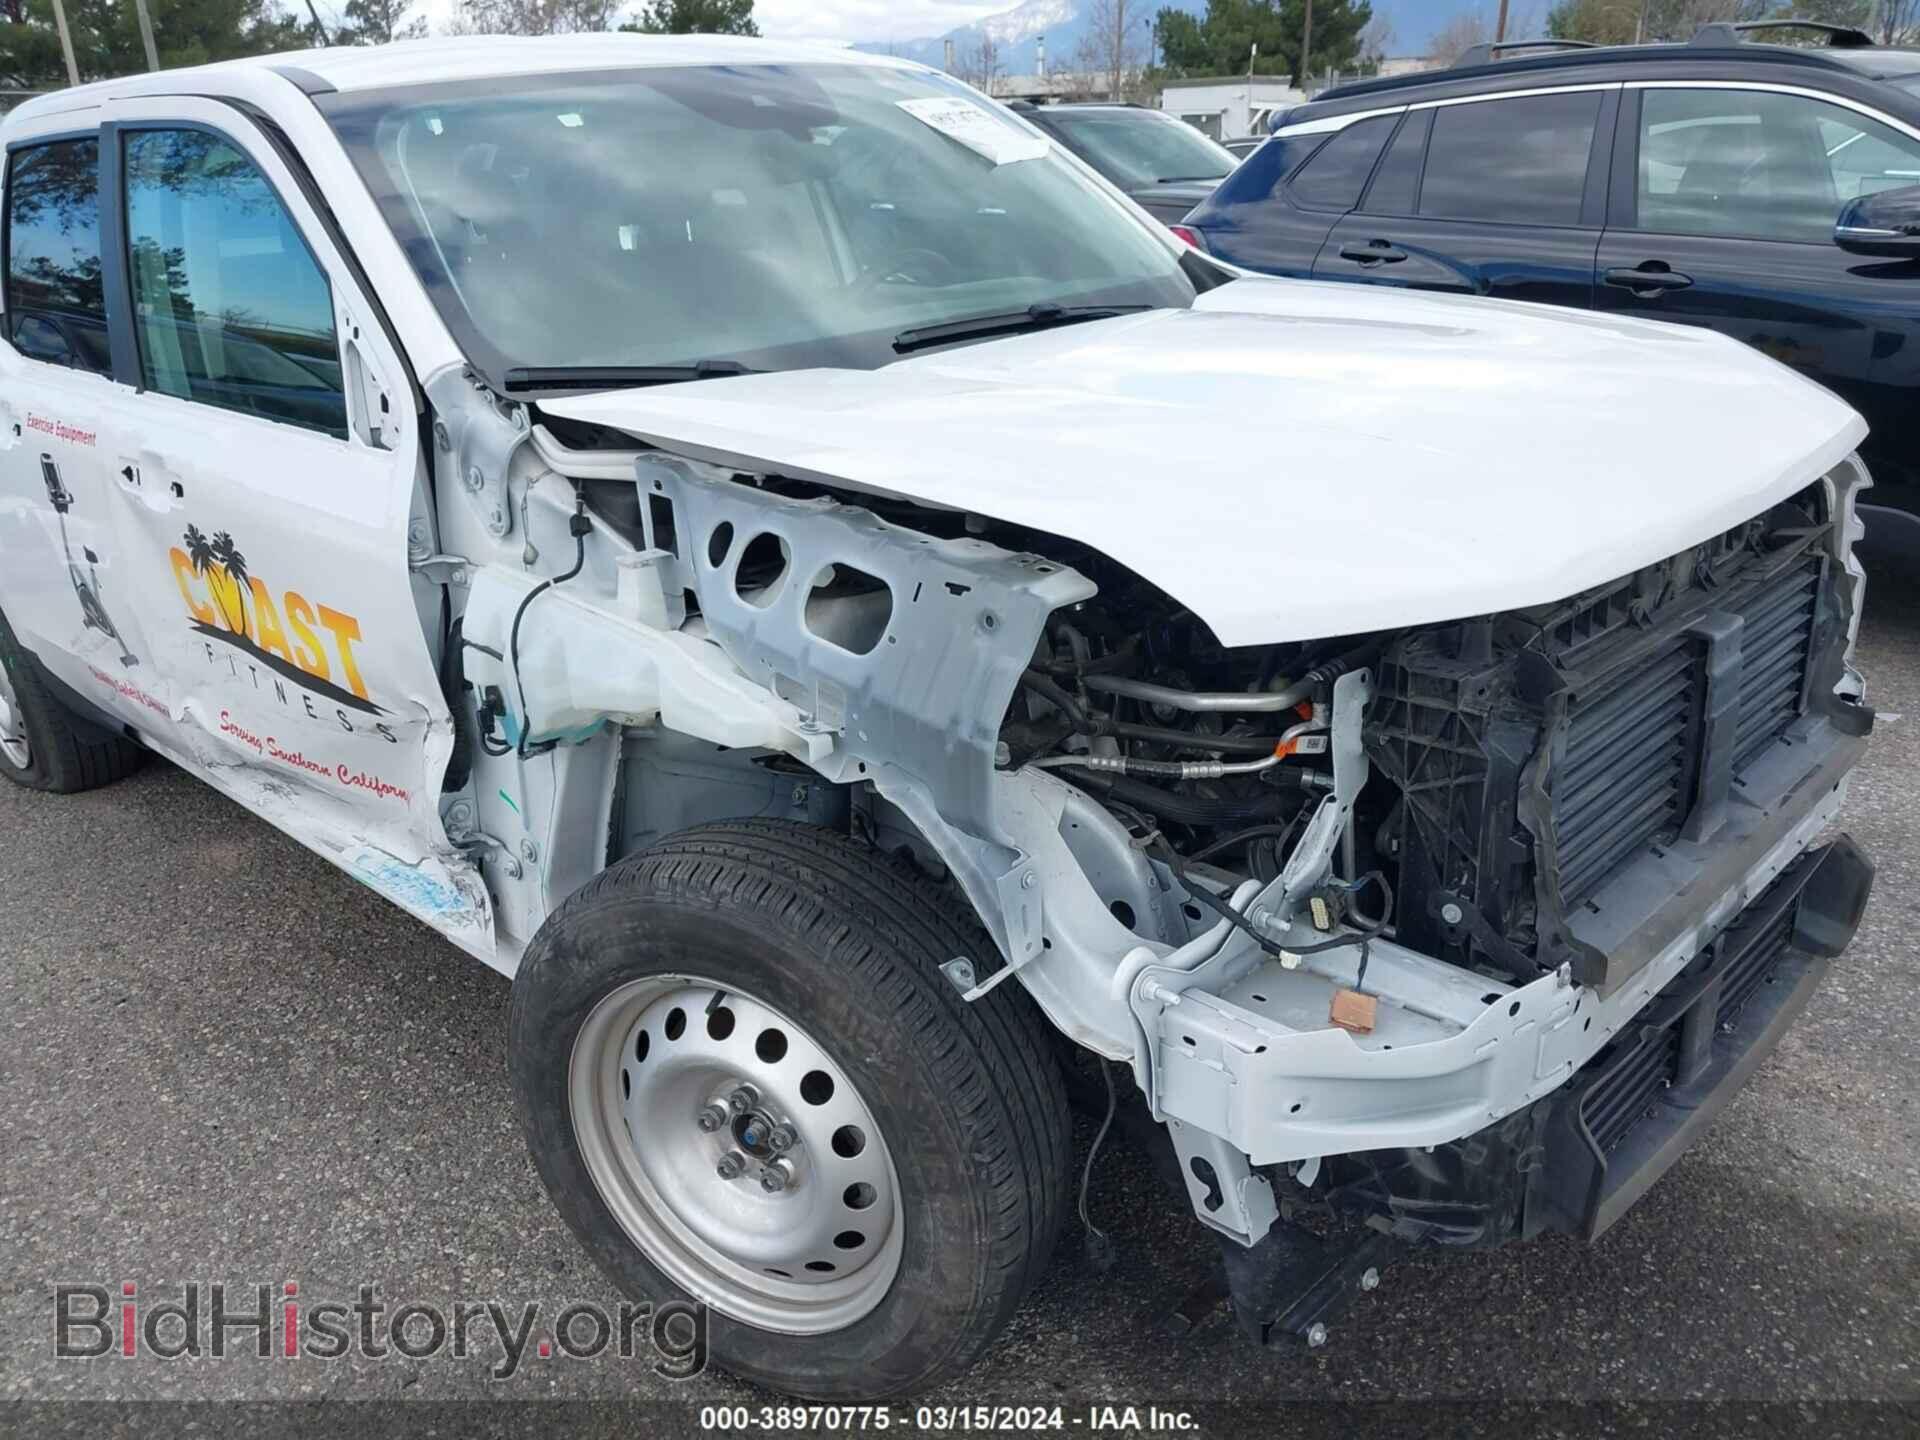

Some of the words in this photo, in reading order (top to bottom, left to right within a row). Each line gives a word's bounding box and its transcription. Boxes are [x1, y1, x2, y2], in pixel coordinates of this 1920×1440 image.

[26, 412, 54, 434] Exercise
[56, 420, 96, 448] Equipment
[169, 546, 369, 700] COAST
[204, 643, 398, 744] FITNESS
[220, 711, 263, 755] Serving
[266, 737, 332, 777] Southern
